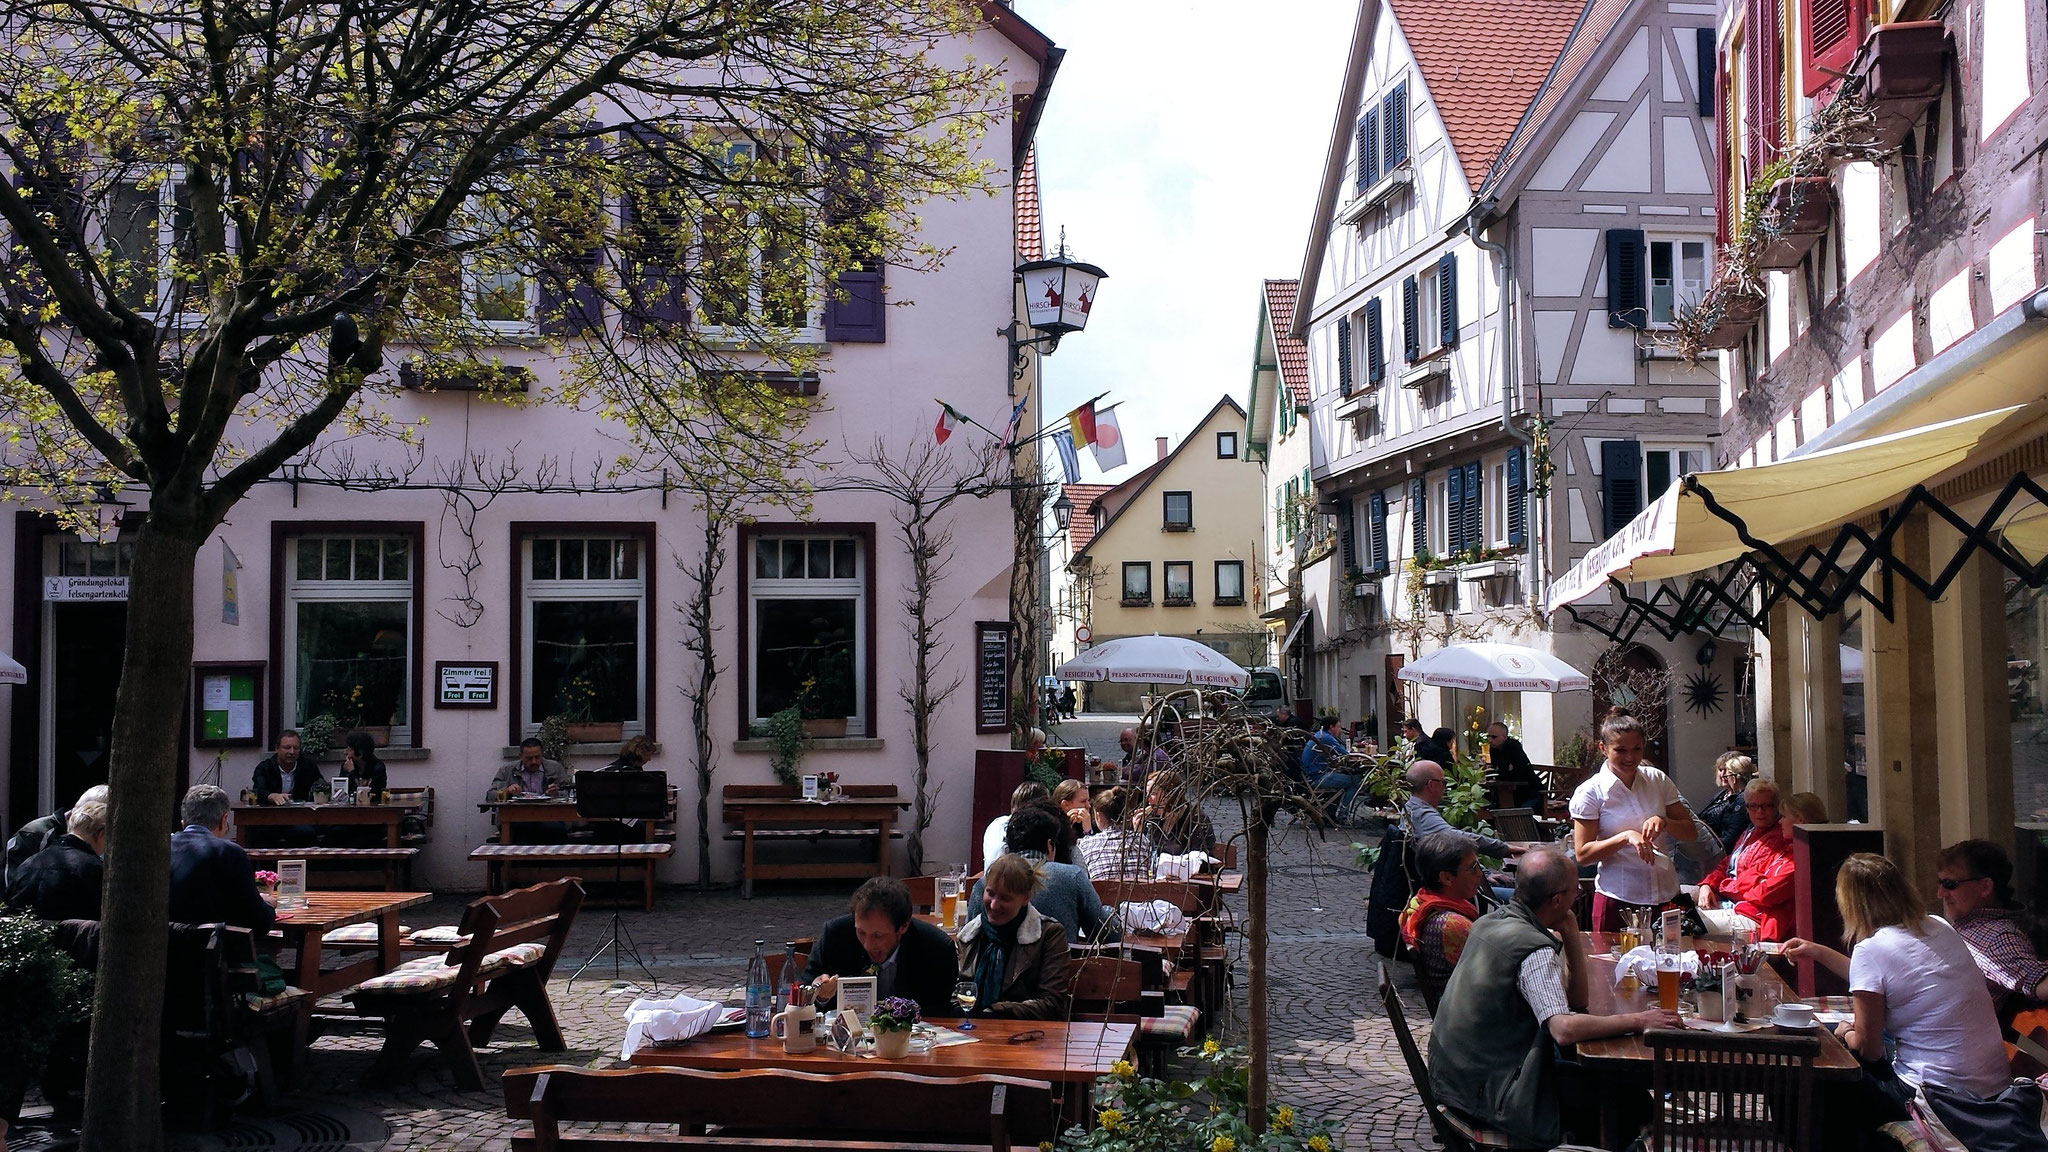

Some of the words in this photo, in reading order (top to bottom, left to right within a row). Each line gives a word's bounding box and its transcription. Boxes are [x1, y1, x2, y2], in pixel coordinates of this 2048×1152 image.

[1029, 301, 1052, 310] HIRSCH
[68, 577, 125, 588] Gründungslokal
[1111, 672, 1185, 680] FELSENGARTENKELLEREI
[1498, 680, 1538, 688] BESIGHEIM
